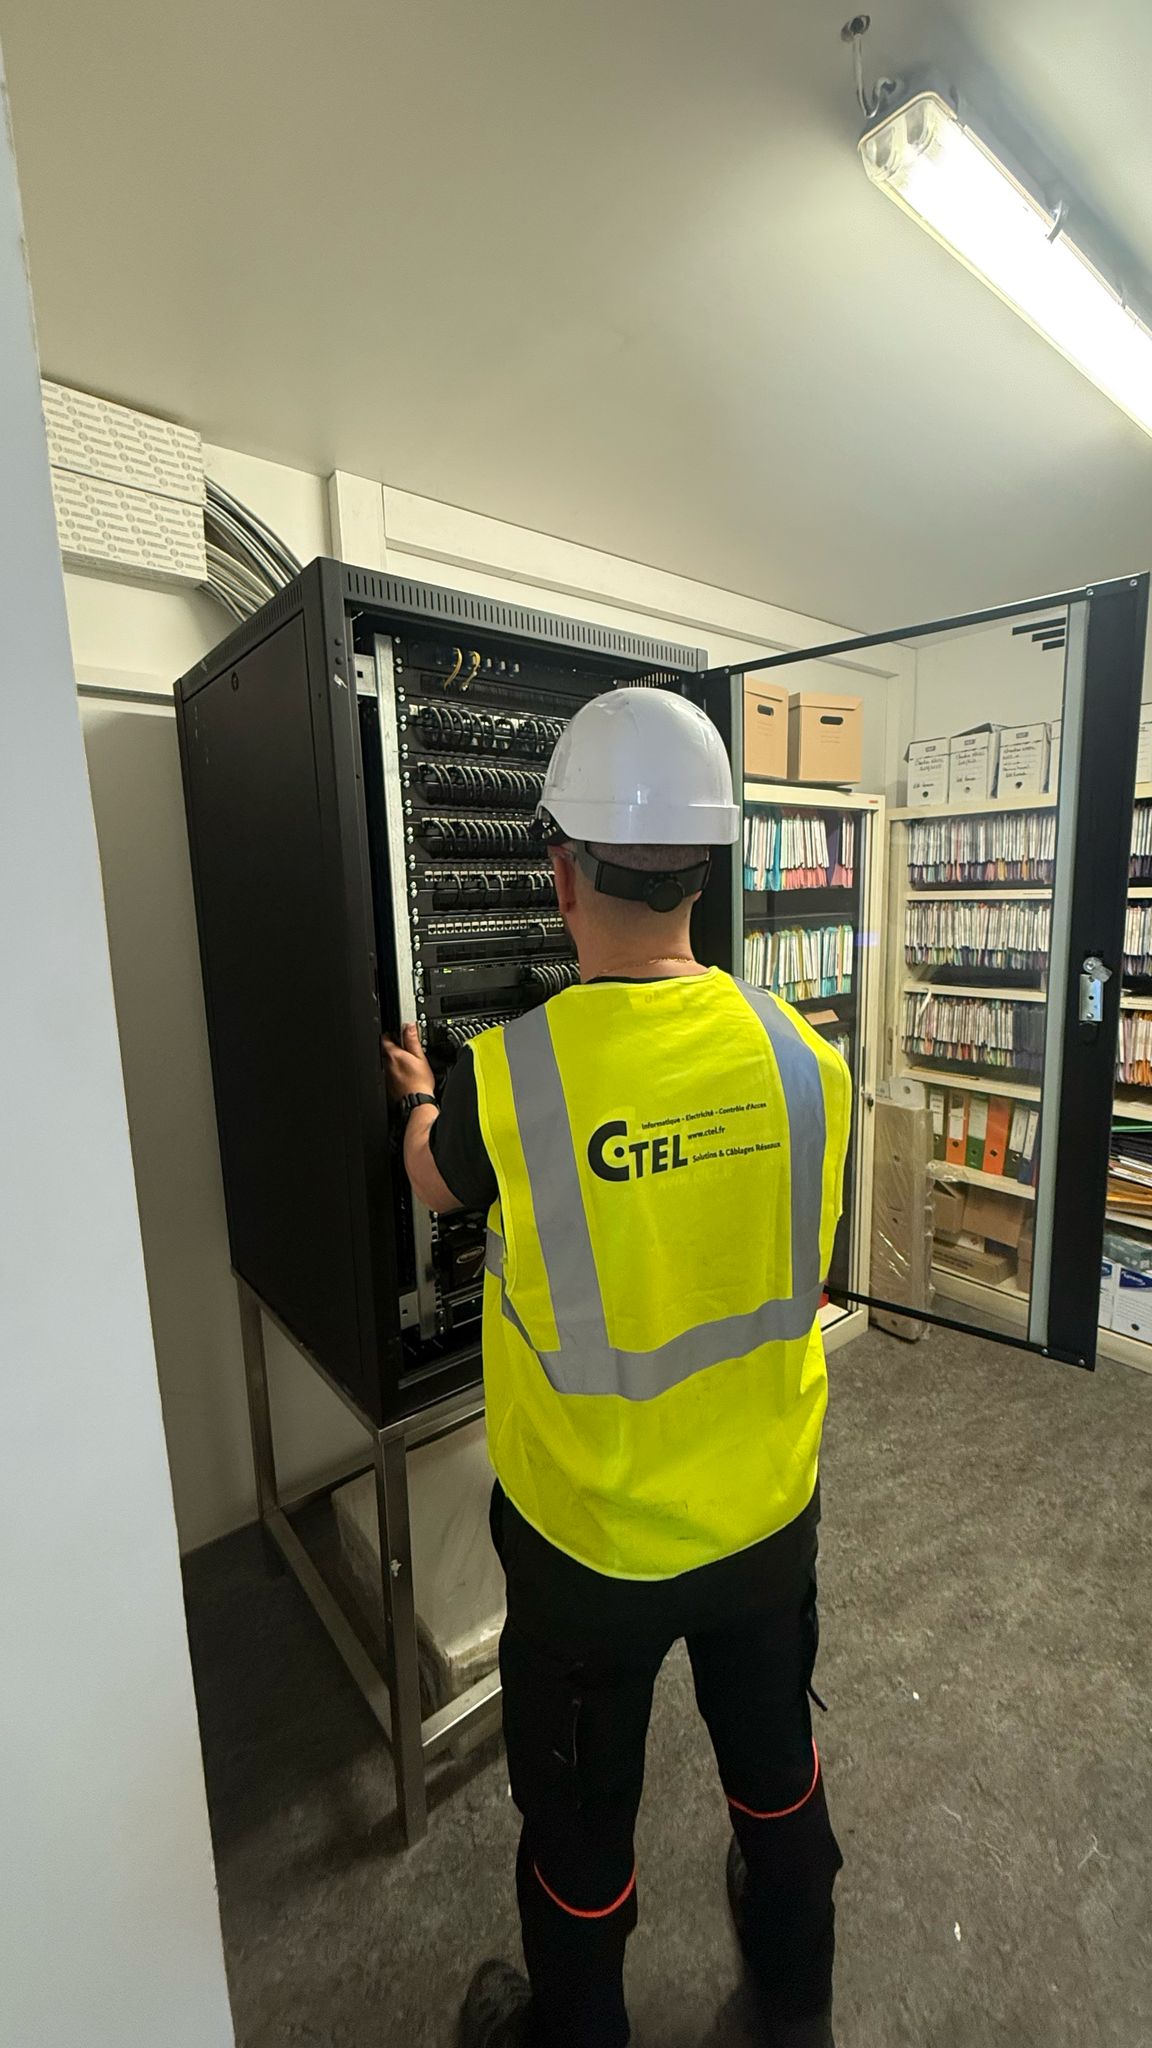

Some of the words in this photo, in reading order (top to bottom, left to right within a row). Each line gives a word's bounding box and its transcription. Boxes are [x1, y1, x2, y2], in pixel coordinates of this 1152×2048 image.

[641, 1118, 681, 1130] Informatique
[718, 1104, 745, 1115] Contrôle
[687, 1125, 726, 1140] www.ctel.fr
[725, 1147, 755, 1157] Câblages
[755, 1142, 781, 1151] Réseaux
